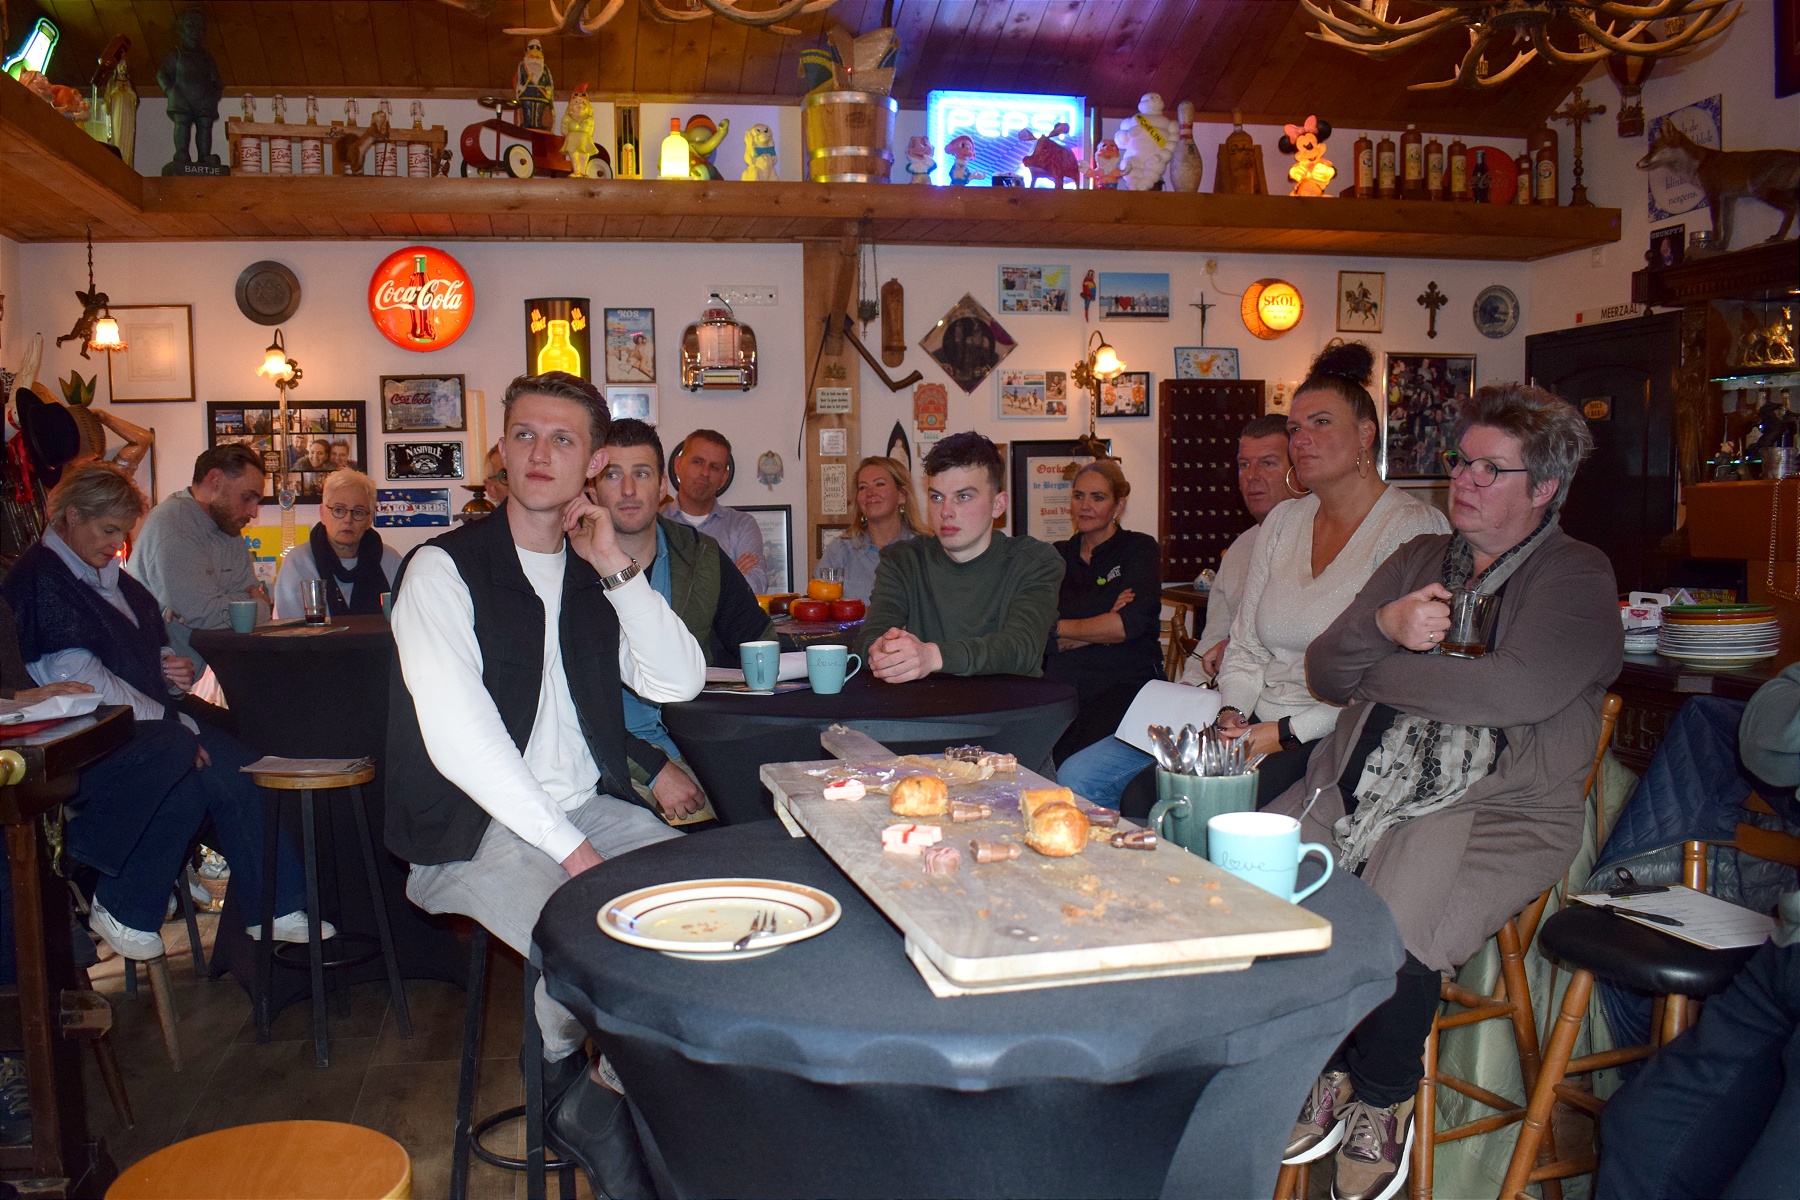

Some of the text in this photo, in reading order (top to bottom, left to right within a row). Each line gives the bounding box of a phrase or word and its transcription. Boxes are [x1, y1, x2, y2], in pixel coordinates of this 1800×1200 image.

[184, 165, 220, 175] BARTJE
[375, 279, 465, 311] Coca-Cola
[1264, 295, 1296, 307] SKOL
[1601, 303, 1638, 319] MEERZAAL
[390, 392, 433, 405] Coca-Cola
[405, 445, 444, 460] NASHVILLE
[377, 503, 448, 512] CABO VERDE
[1040, 507, 1058, 516] Paul
